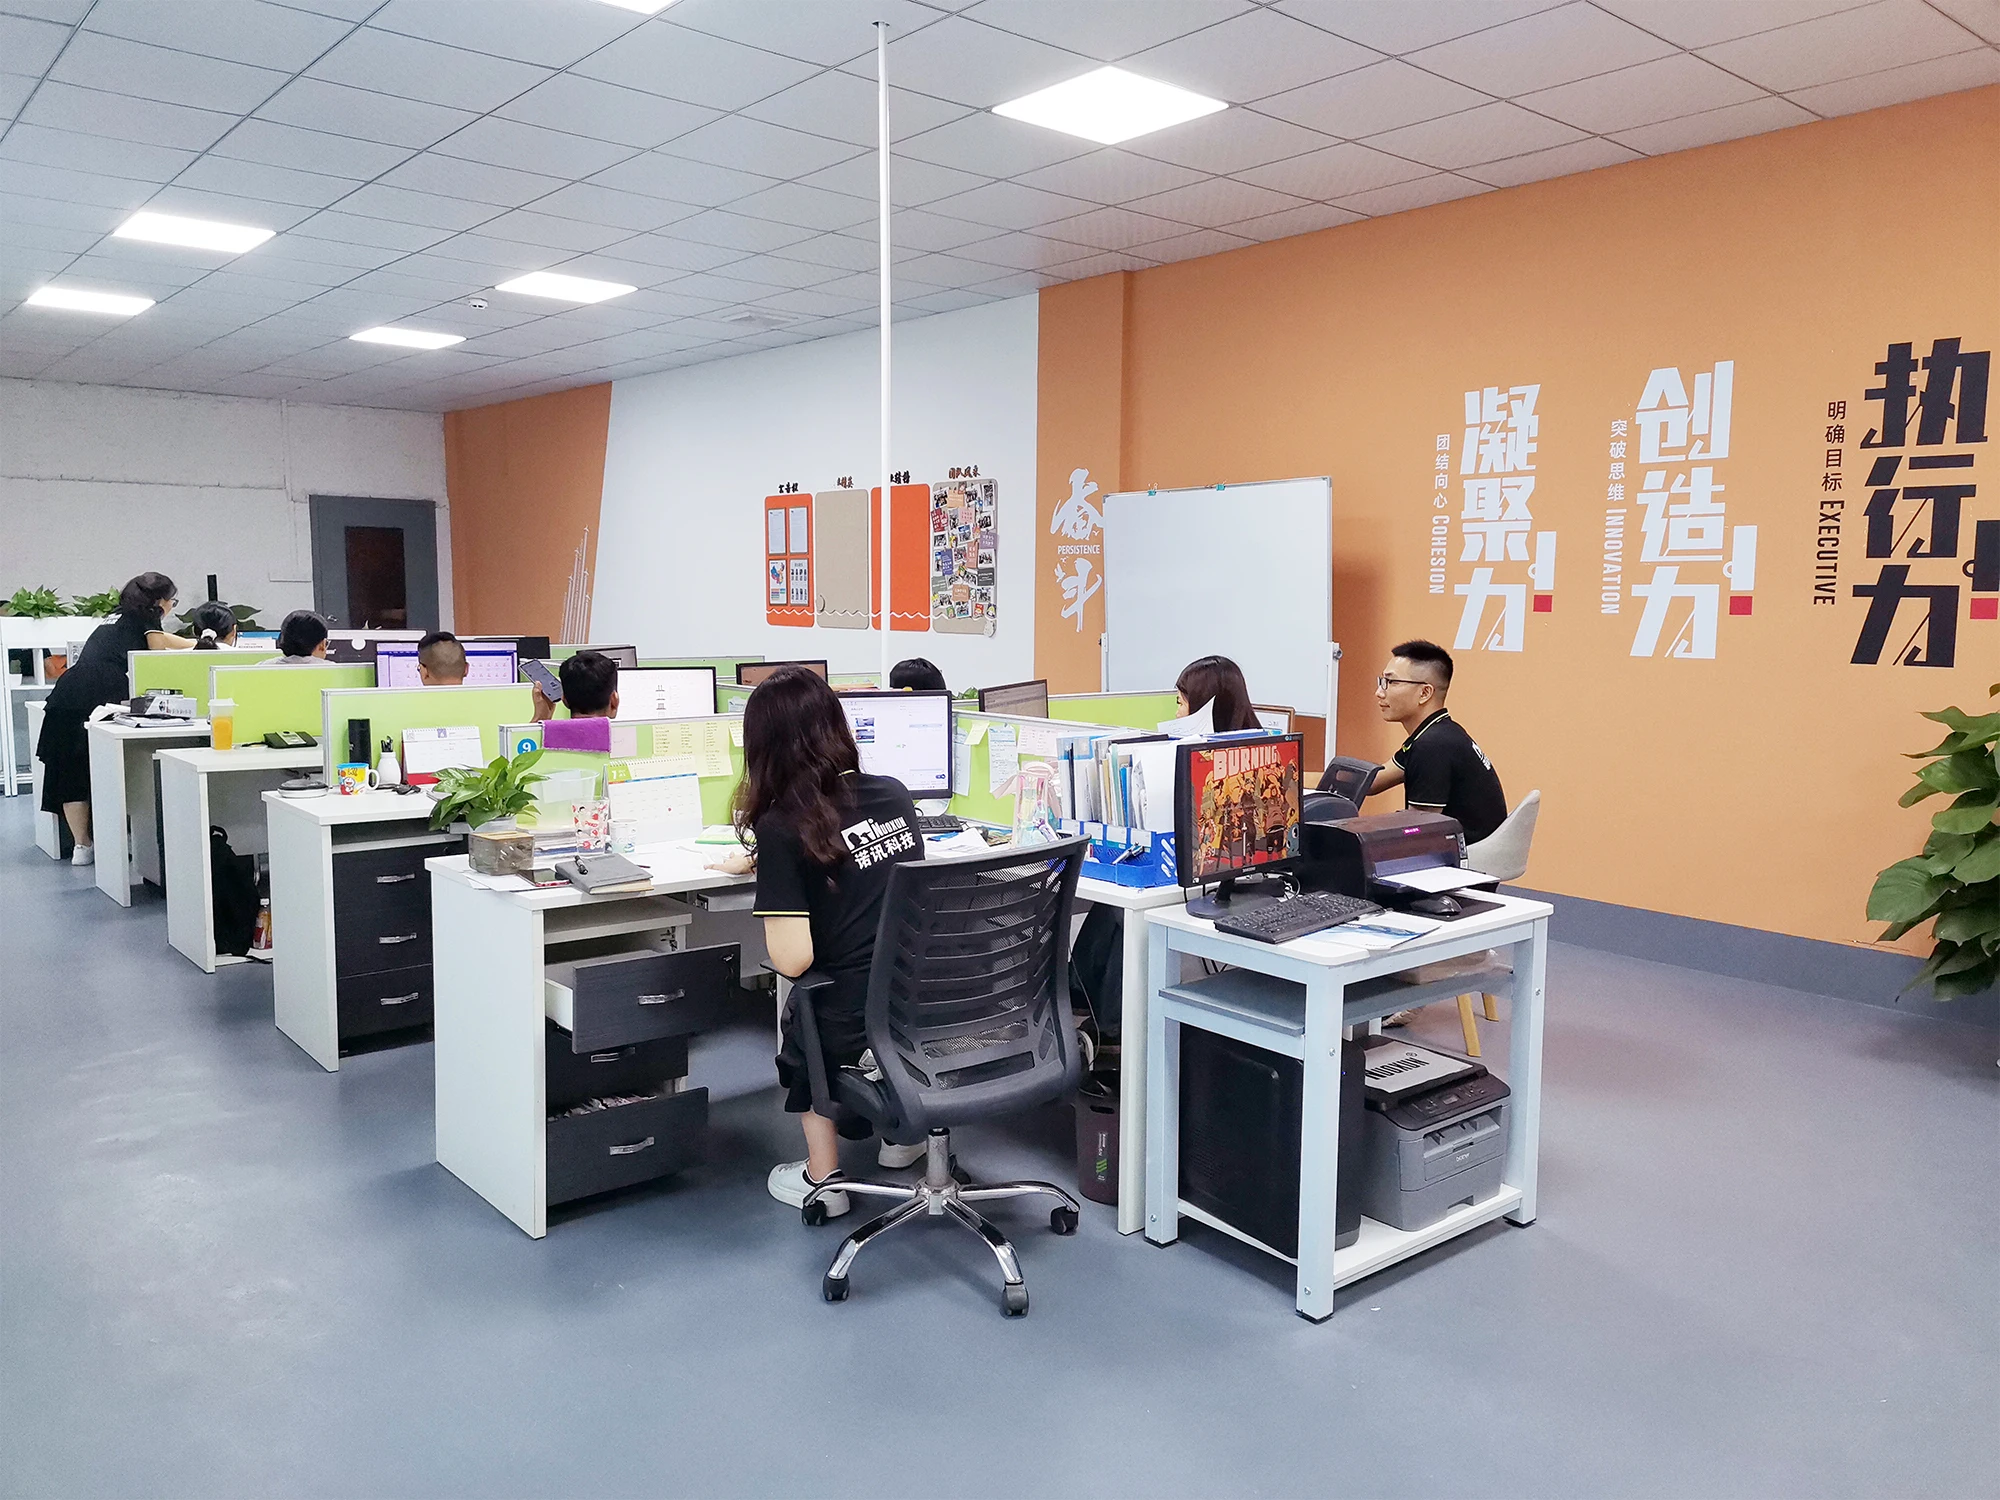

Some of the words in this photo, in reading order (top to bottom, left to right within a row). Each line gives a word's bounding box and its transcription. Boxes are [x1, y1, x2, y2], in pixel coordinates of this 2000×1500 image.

[1433, 433, 1451, 510] 团结向心
[1606, 418, 1629, 503] 突破思维
[1821, 400, 1848, 493] 明确目标
[1057, 544, 1101, 555] PERSISTENCE
[1429, 515, 1451, 595] COHESION
[1600, 508, 1628, 616] INNOVATION
[1812, 500, 1846, 607] EXECUTIVE
[521, 741, 532, 754] 9
[1213, 745, 1277, 781] BURNING
[854, 831, 916, 870] 诺讯科技
